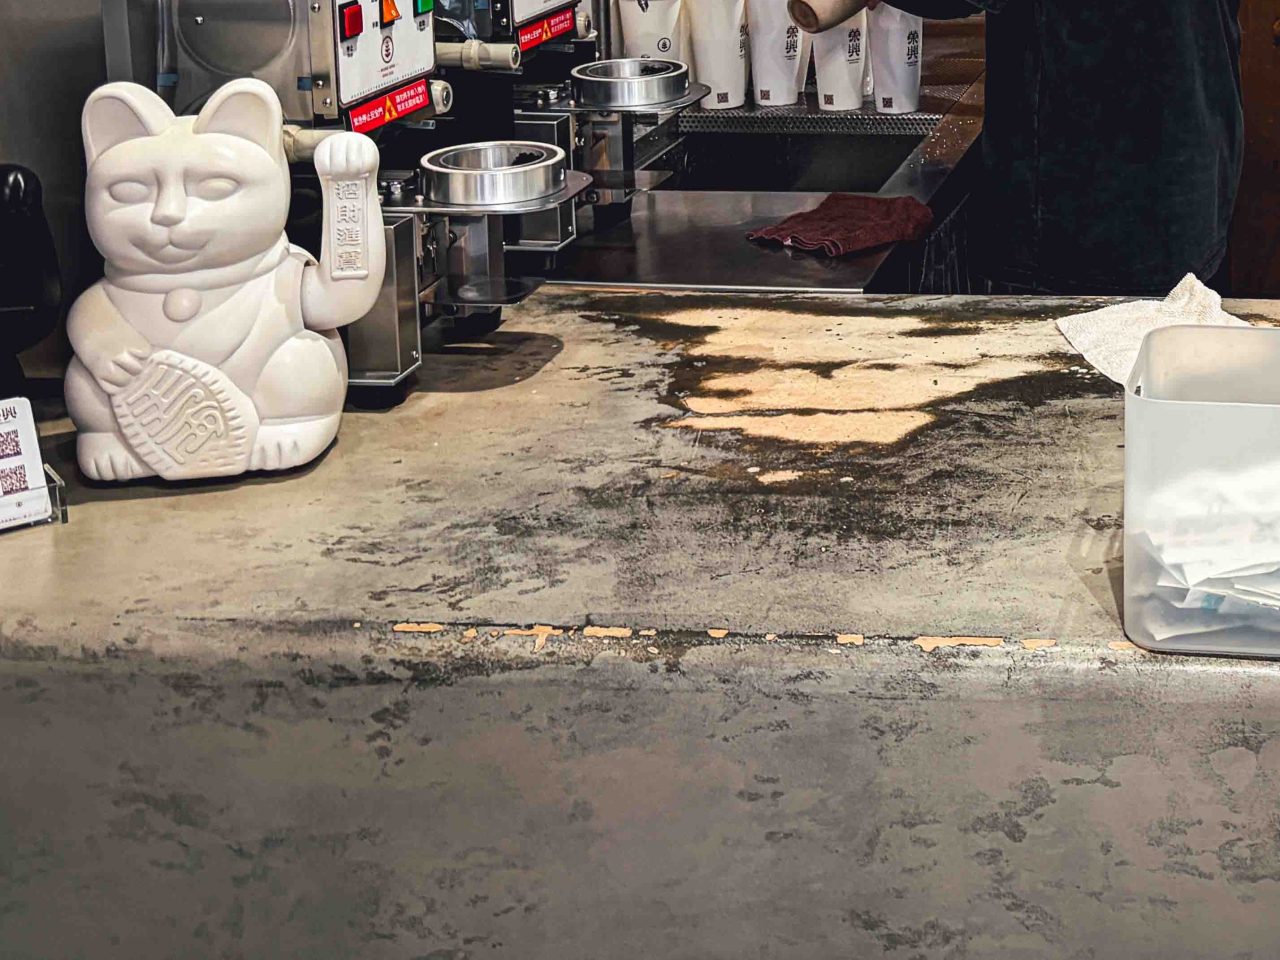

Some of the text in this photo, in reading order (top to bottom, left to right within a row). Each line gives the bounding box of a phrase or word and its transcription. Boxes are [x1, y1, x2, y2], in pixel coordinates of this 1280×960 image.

[785, 25, 798, 54] 榮興
[848, 28, 861, 58] 榮興
[907, 30, 919, 60] 榮興
